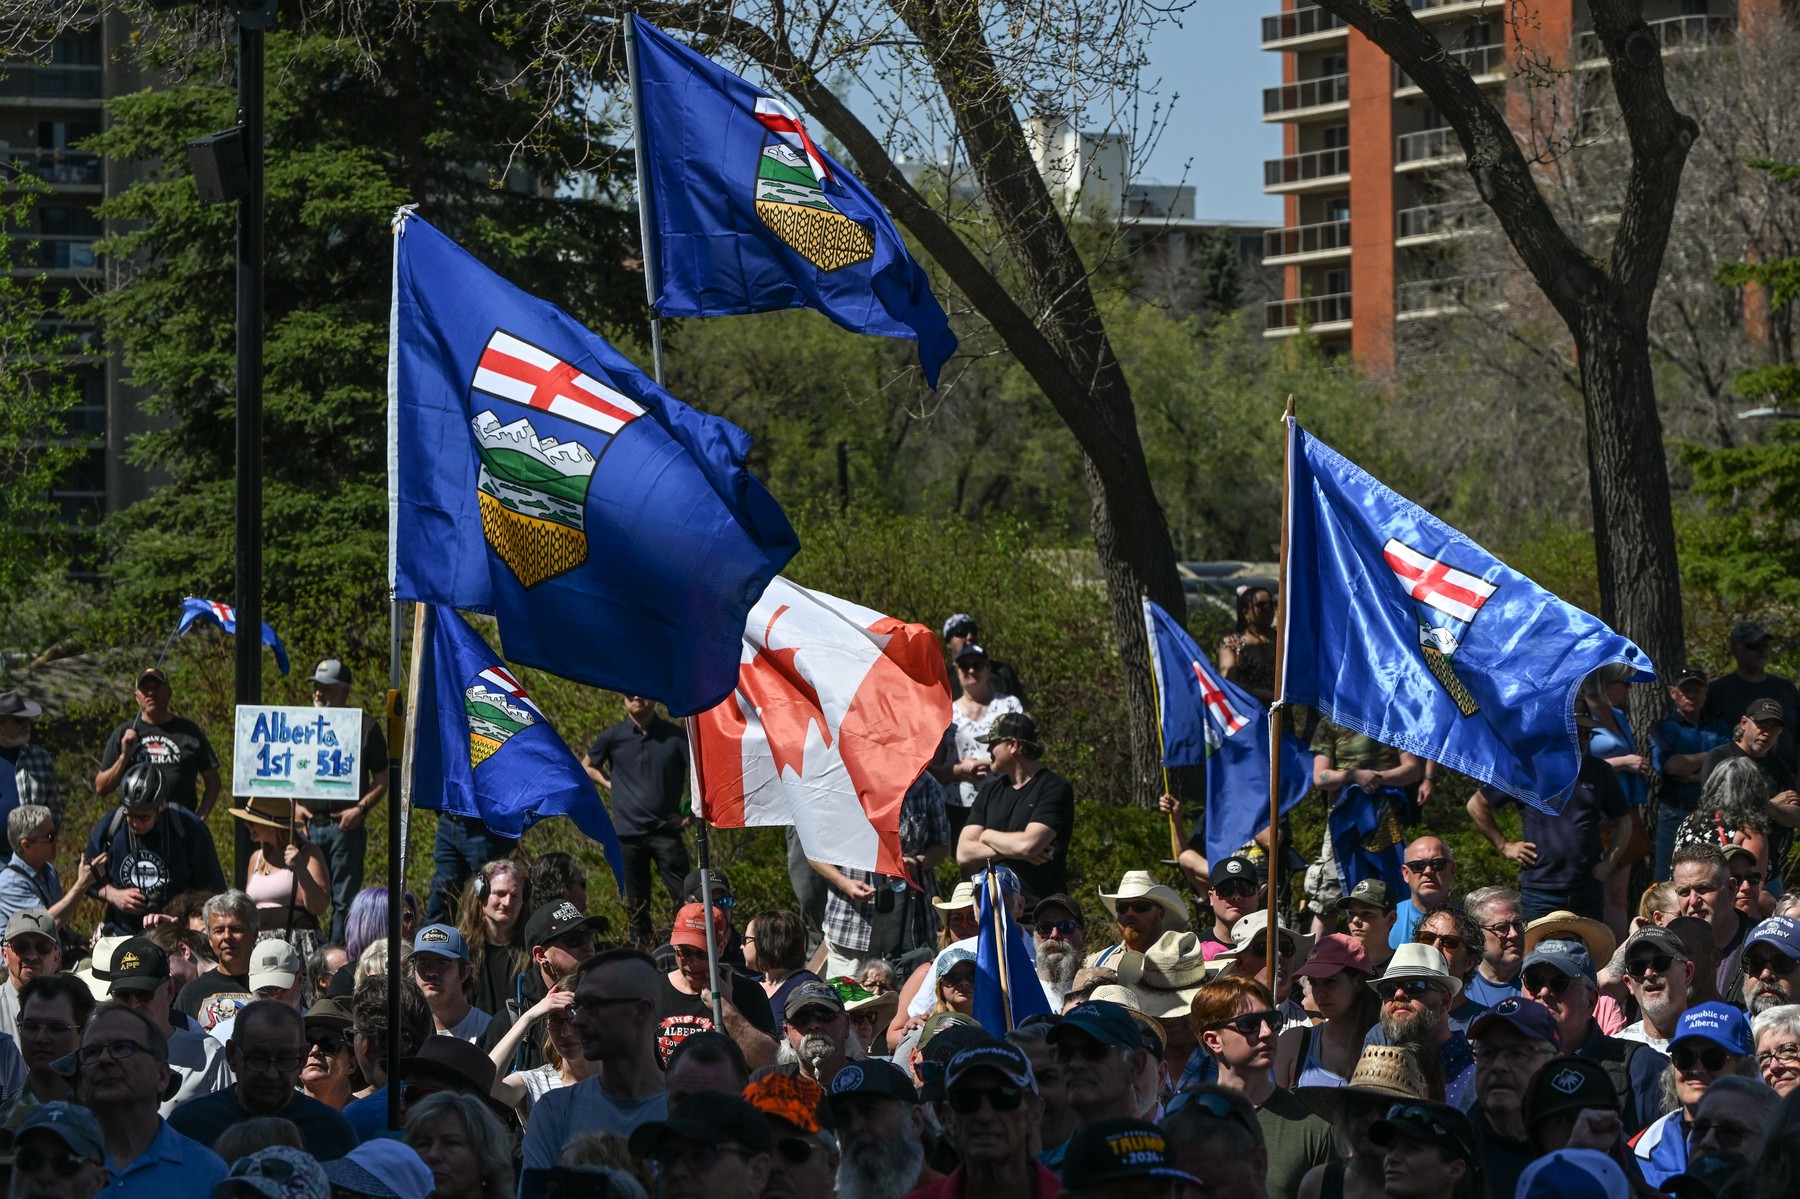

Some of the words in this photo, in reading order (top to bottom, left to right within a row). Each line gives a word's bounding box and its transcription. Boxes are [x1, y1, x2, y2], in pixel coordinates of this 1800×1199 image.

[250, 711, 339, 747] Alberta
[256, 743, 294, 777] 1st
[315, 749, 355, 776] 51st
[1754, 929, 1790, 938] HOCKEY
[668, 1015, 694, 1024] THIS
[1685, 1010, 1718, 1022] Republic
[1689, 1020, 1719, 1029] Alberta
[665, 1039, 681, 1047] LOV
[953, 1046, 1021, 1065] TaylorMade
[1108, 1136, 1166, 1156] TRUMP
